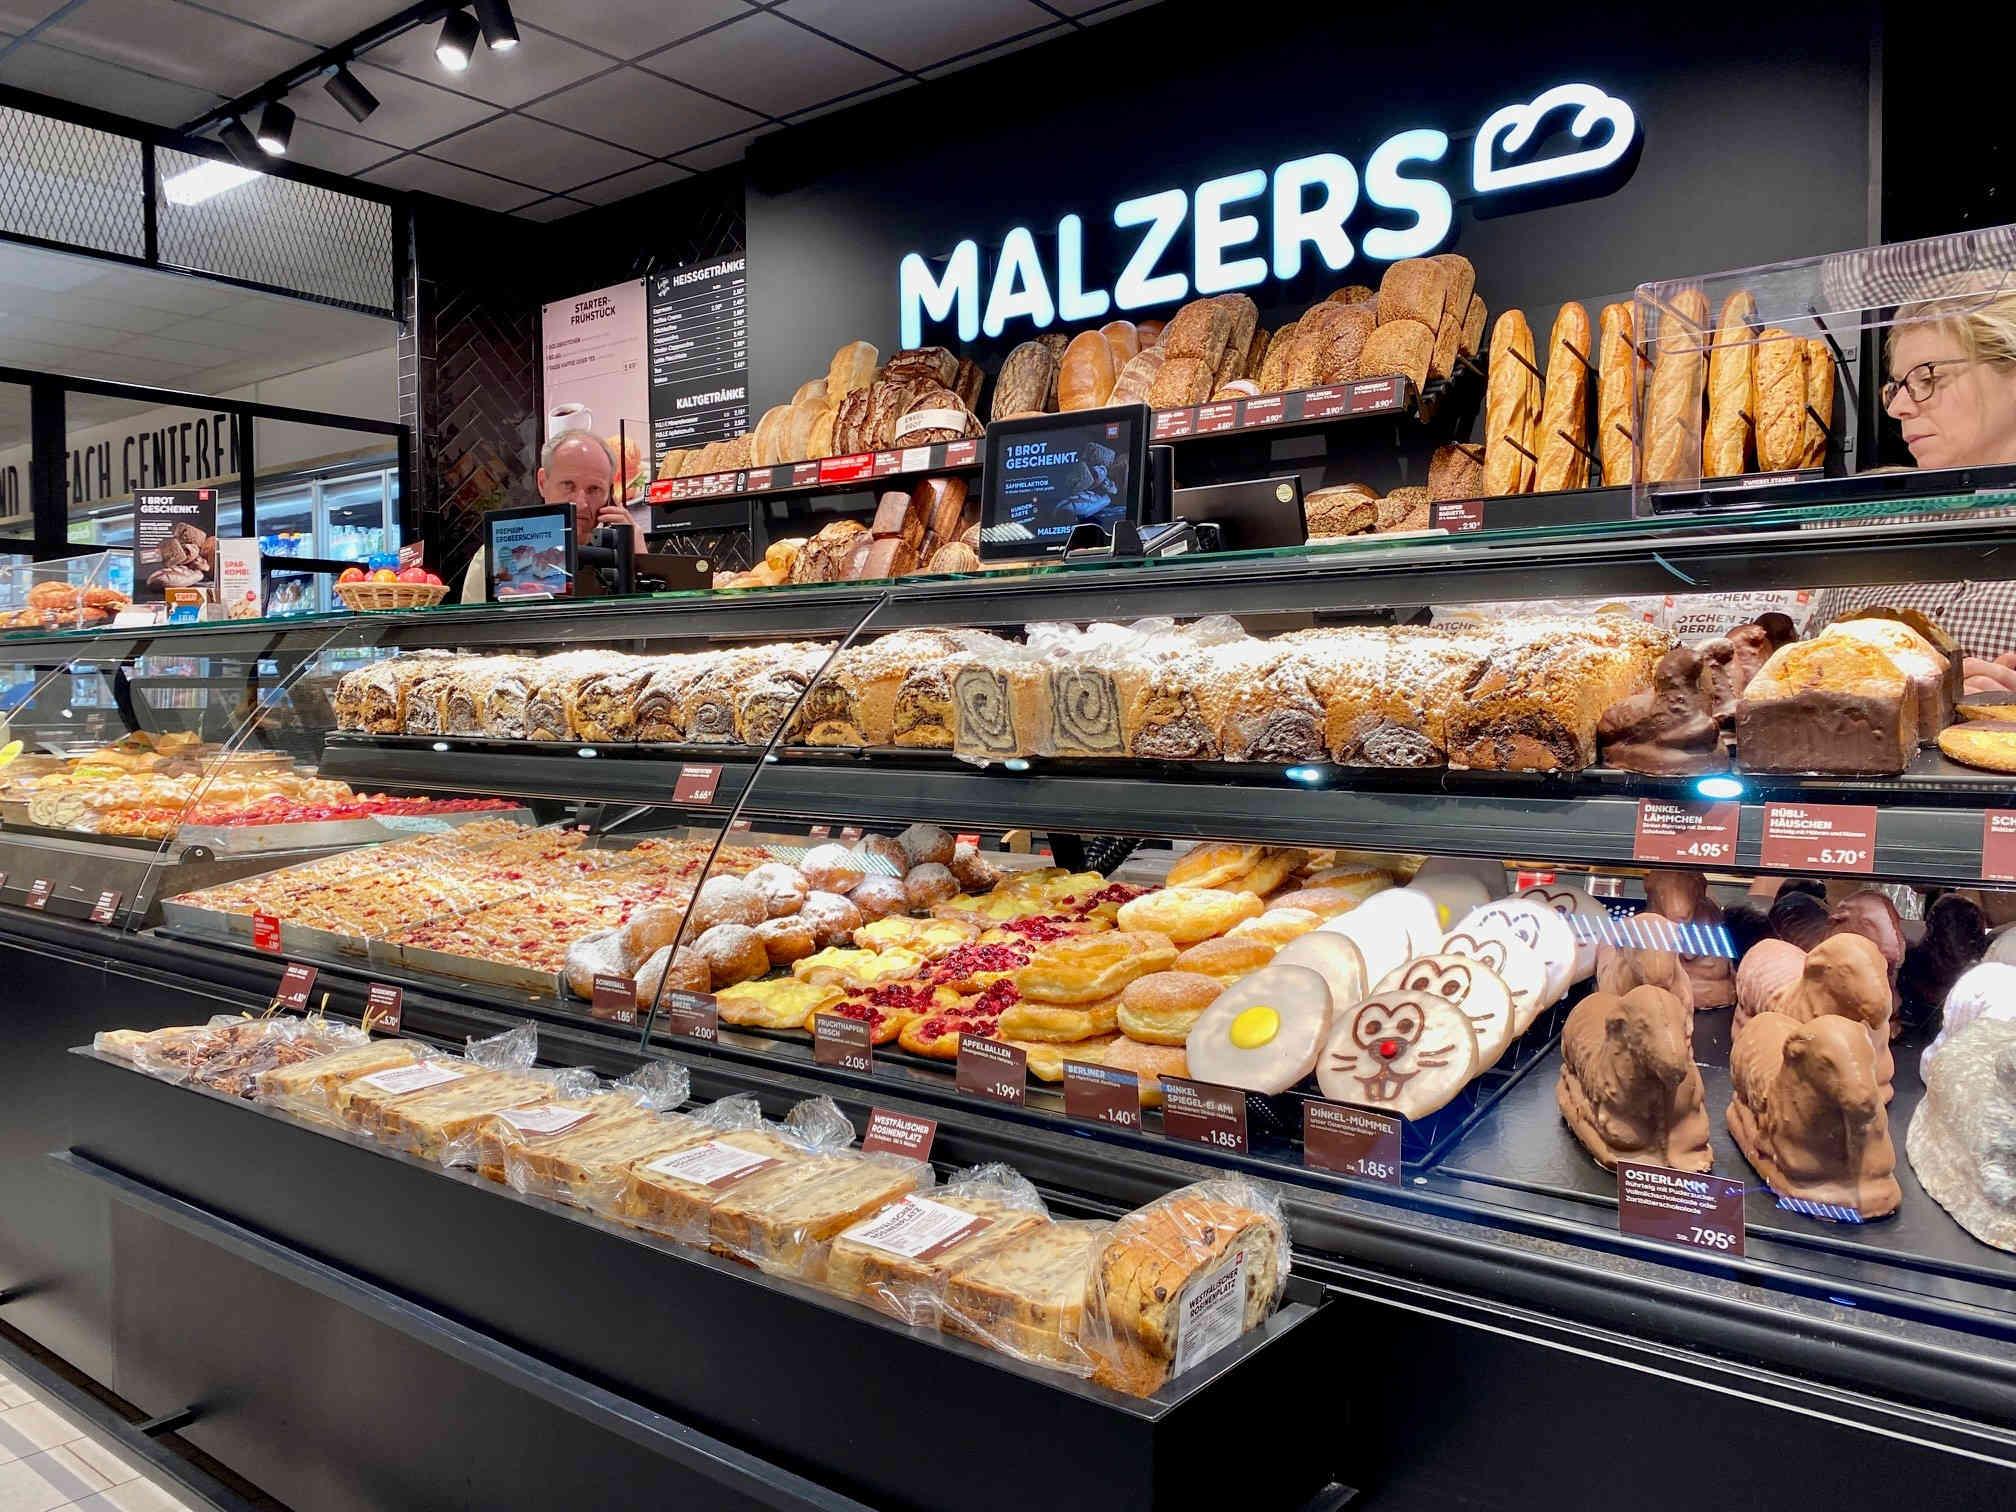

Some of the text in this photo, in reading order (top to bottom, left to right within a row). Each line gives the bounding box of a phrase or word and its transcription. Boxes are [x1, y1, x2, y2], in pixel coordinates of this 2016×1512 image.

[900, 128, 1453, 350] MALZERS
[673, 259, 745, 287] HEISSGETRÄNKE
[575, 297, 611, 313] STARTER-
[571, 306, 615, 325] FRÜHSTÜCK
[676, 387, 745, 409] KALTGETRÄNKE
[1016, 443, 1047, 456] BROT
[1006, 452, 1079, 469] GESCHENKT.
[1005, 480, 1049, 490] SAMMELAKTION
[148, 496, 175, 505] BROT
[141, 505, 200, 514] GESCHENKT.
[1037, 526, 1071, 536] MALZERS
[1644, 804, 1685, 814] DINKEL-
[1771, 808, 1808, 818] RÜBLI-
[1643, 813, 1703, 824] LÄMMCHEN
[1770, 818, 1832, 829] HÄUSCHEN
[1067, 1064, 1105, 1078] BERLINER
[1167, 1084, 1198, 1096] DINKEL
[874, 1114, 929, 1134] WESTFÄLISCHER
[871, 1125, 922, 1143] ROSINENPLATZ
[1189, 1268, 1238, 1309] WESTFÄLISCHER
[1190, 1279, 1236, 1319] ROSINENPLATZ
